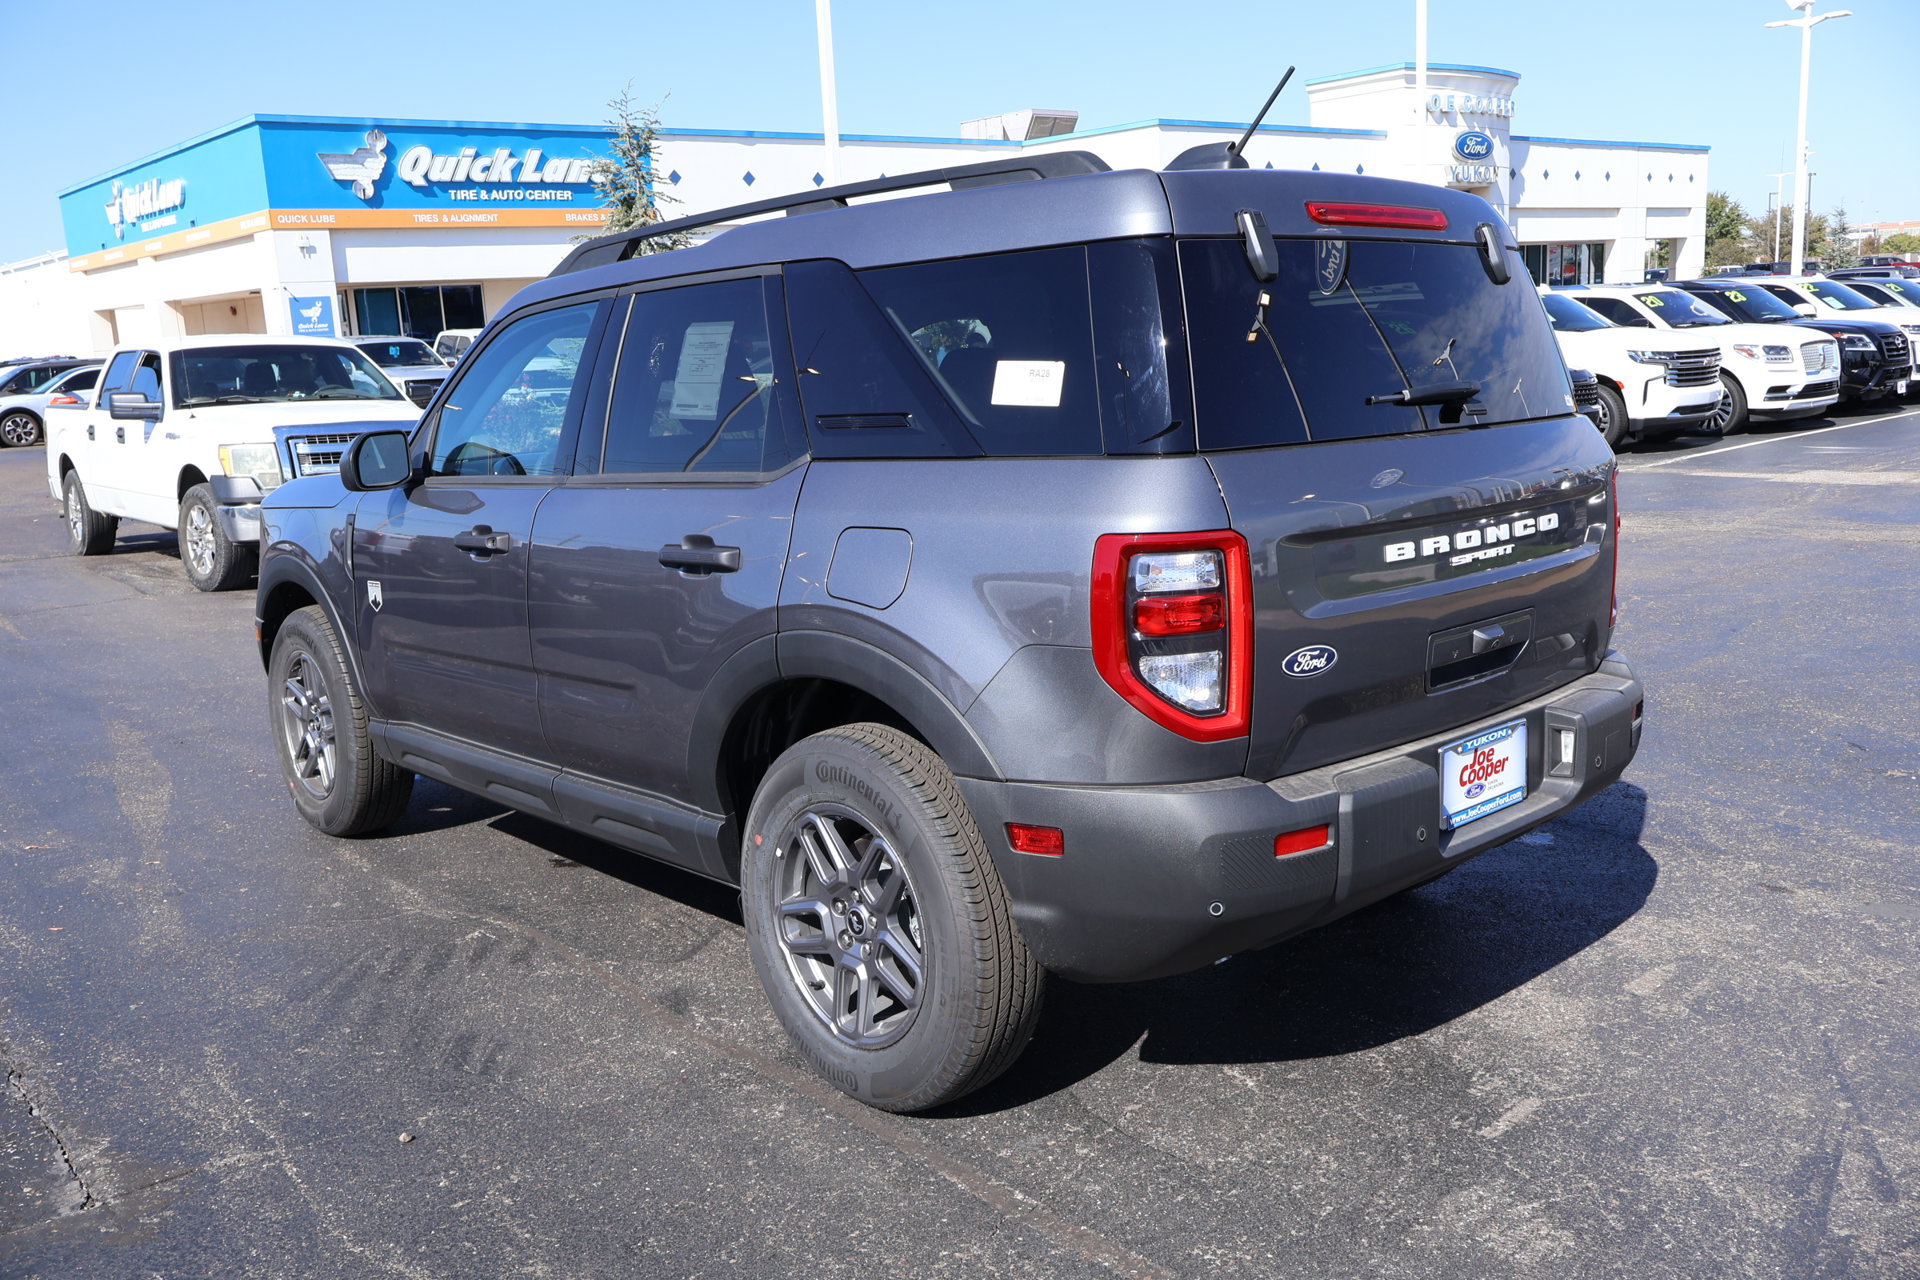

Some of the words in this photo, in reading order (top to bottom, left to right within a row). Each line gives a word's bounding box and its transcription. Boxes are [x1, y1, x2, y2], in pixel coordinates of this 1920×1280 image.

[1427, 94, 1456, 112] OE
[1464, 136, 1488, 154] Ford
[398, 144, 521, 187] Quick
[449, 189, 479, 201] TIRE
[480, 190, 489, 200] &
[491, 190, 524, 201] AUTO
[526, 190, 573, 201] CENTER
[277, 214, 308, 224] QUICK
[310, 214, 336, 223] LUBE
[413, 214, 438, 222] TIRES
[443, 214, 449, 222] &
[450, 214, 498, 222] ALIGNMENT
[565, 213, 599, 222] BRAKES
[1383, 513, 1559, 563] BRONCO
[1449, 544, 1516, 566] SPORT
[1293, 650, 1328, 672] Ford
[1466, 728, 1507, 750] YUKON
[1469, 747, 1495, 770] Joe
[1459, 756, 1509, 787] Cooper
[816, 760, 894, 819] Continental
[1449, 791, 1523, 825] www.JoeCooperFord.com
